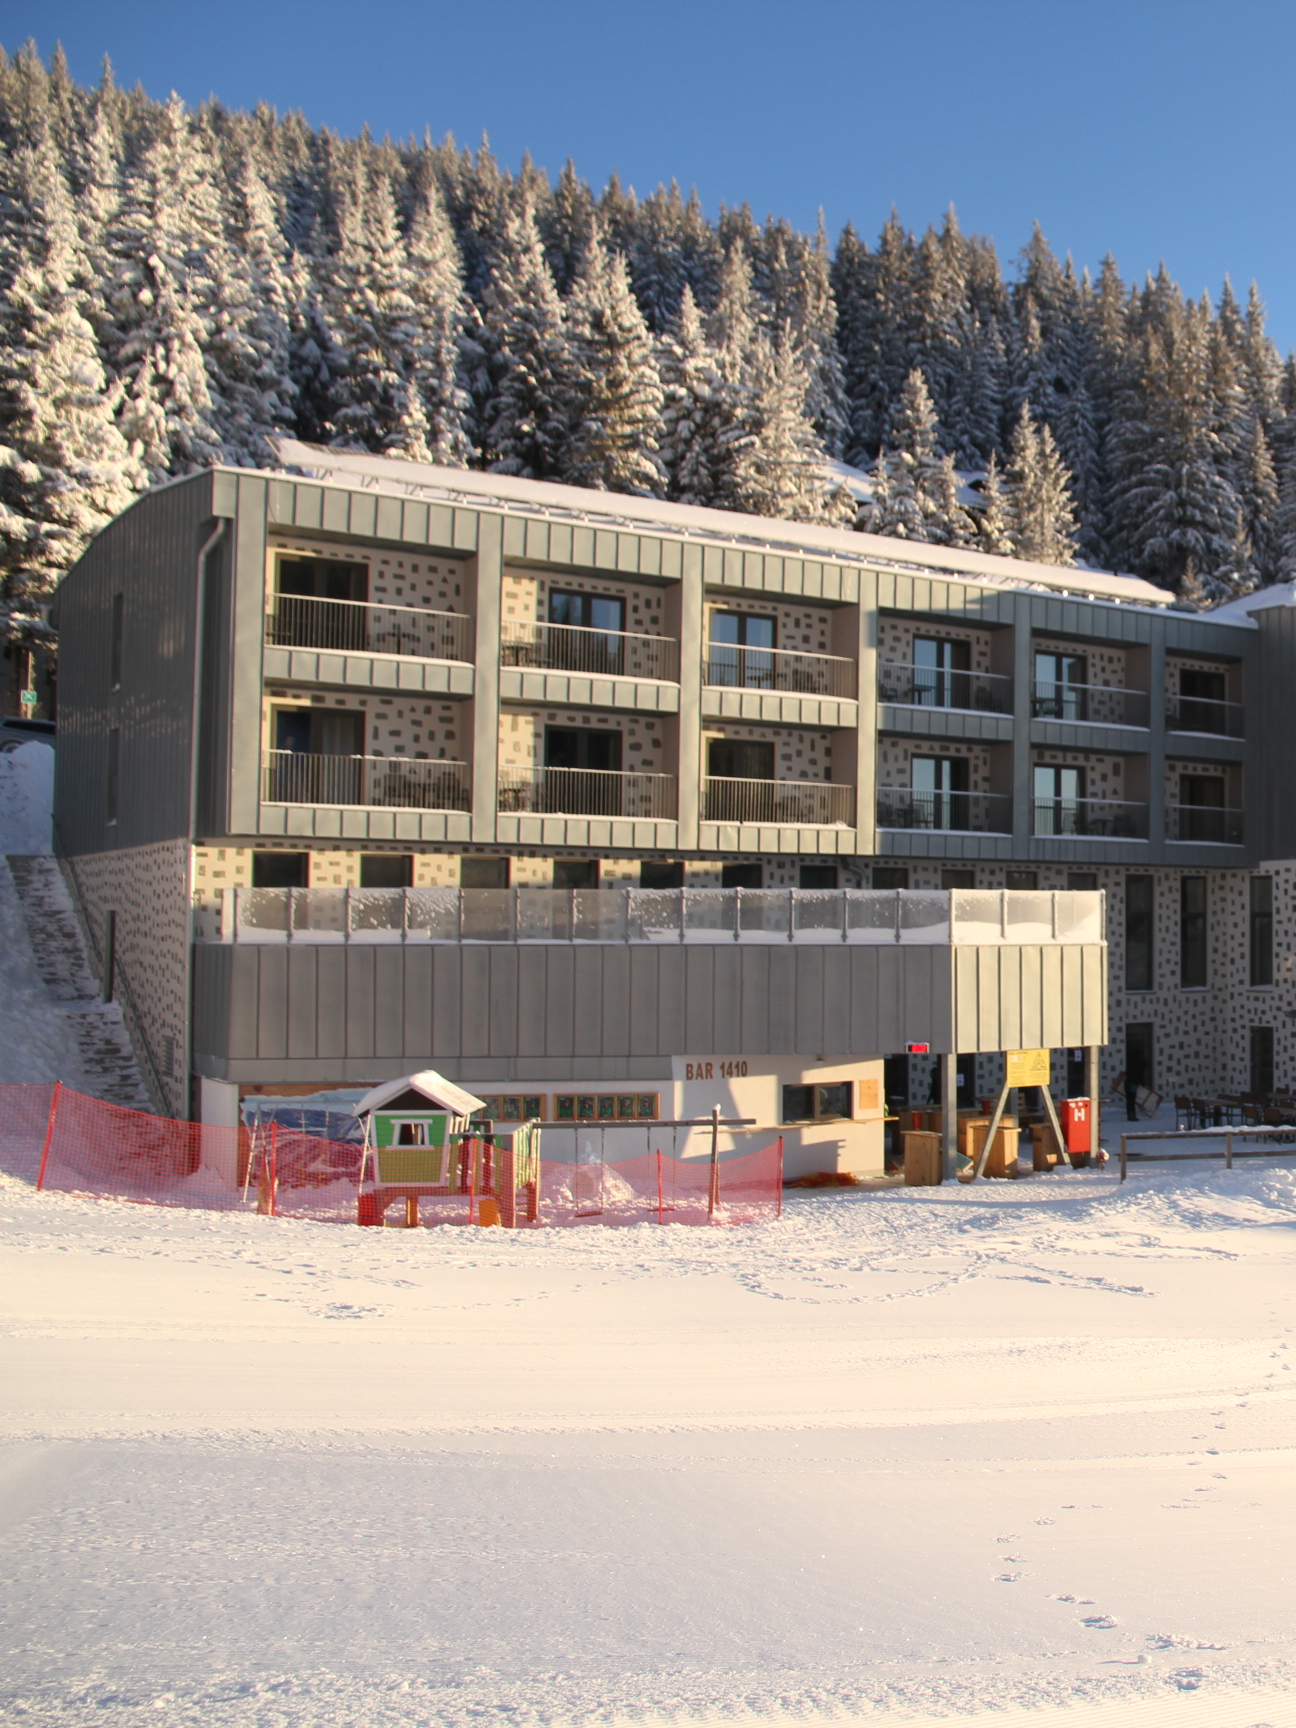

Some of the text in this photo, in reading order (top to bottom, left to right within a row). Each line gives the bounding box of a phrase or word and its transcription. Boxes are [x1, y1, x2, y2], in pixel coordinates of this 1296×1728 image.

[686, 1060, 748, 1081] BAR 1410
[1074, 1108, 1085, 1122] H
